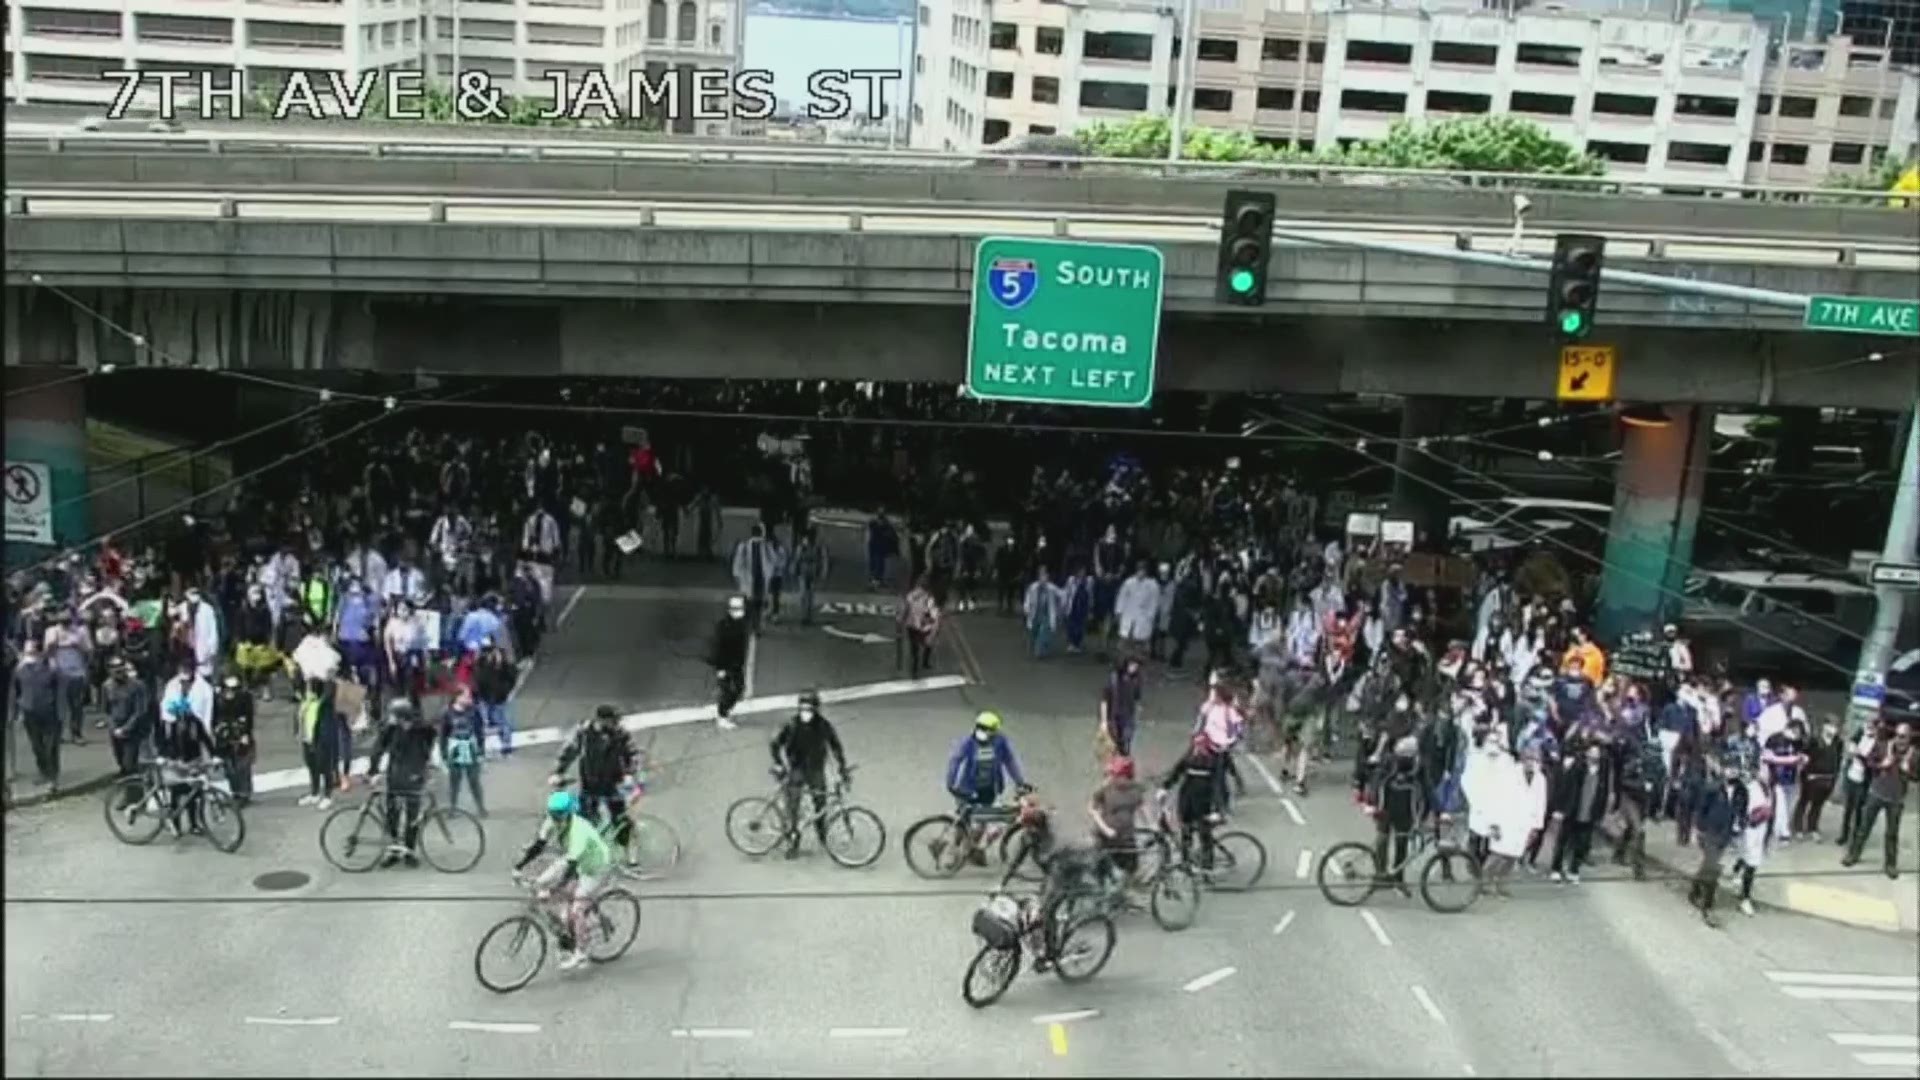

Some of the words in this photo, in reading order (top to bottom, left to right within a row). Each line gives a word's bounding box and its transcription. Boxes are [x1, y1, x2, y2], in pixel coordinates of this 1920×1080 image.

[1002, 271, 1021, 299] 5
[1820, 301, 1859, 324] 7TH
[1870, 305, 1915, 329] AVE
[1002, 323, 1127, 354] Tacoma
[983, 363, 1056, 384] NEXT
[1070, 368, 1136, 390] LEFT
